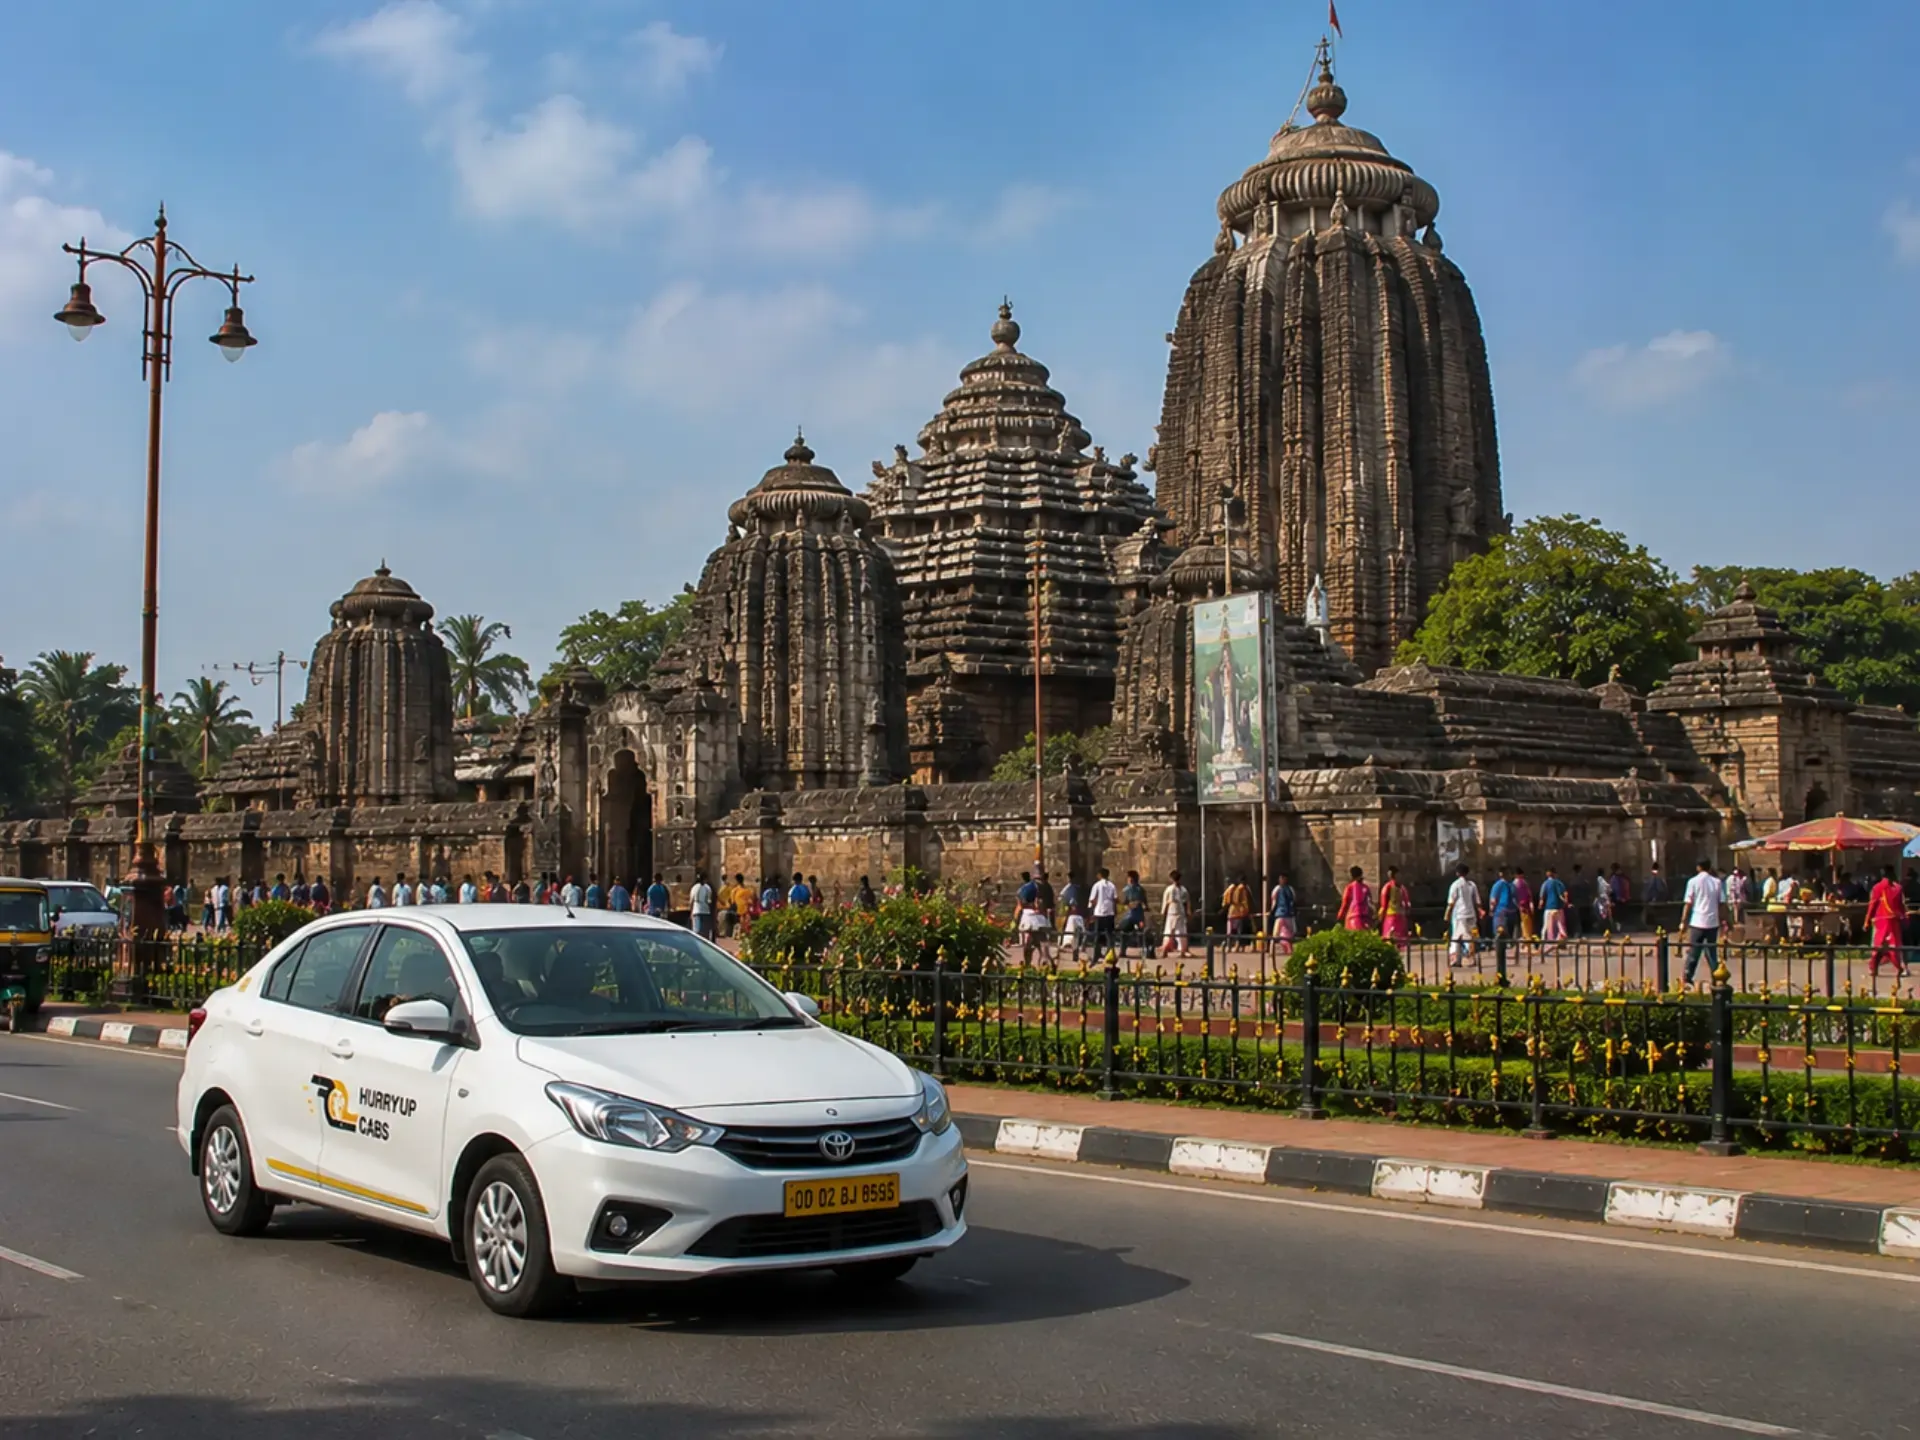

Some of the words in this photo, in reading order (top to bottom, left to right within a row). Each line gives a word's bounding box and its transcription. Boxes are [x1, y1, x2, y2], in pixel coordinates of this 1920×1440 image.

[359, 1087, 417, 1117] HURRYUP
[359, 1116, 390, 1140] CABS
[818, 1187, 835, 1207] 02
